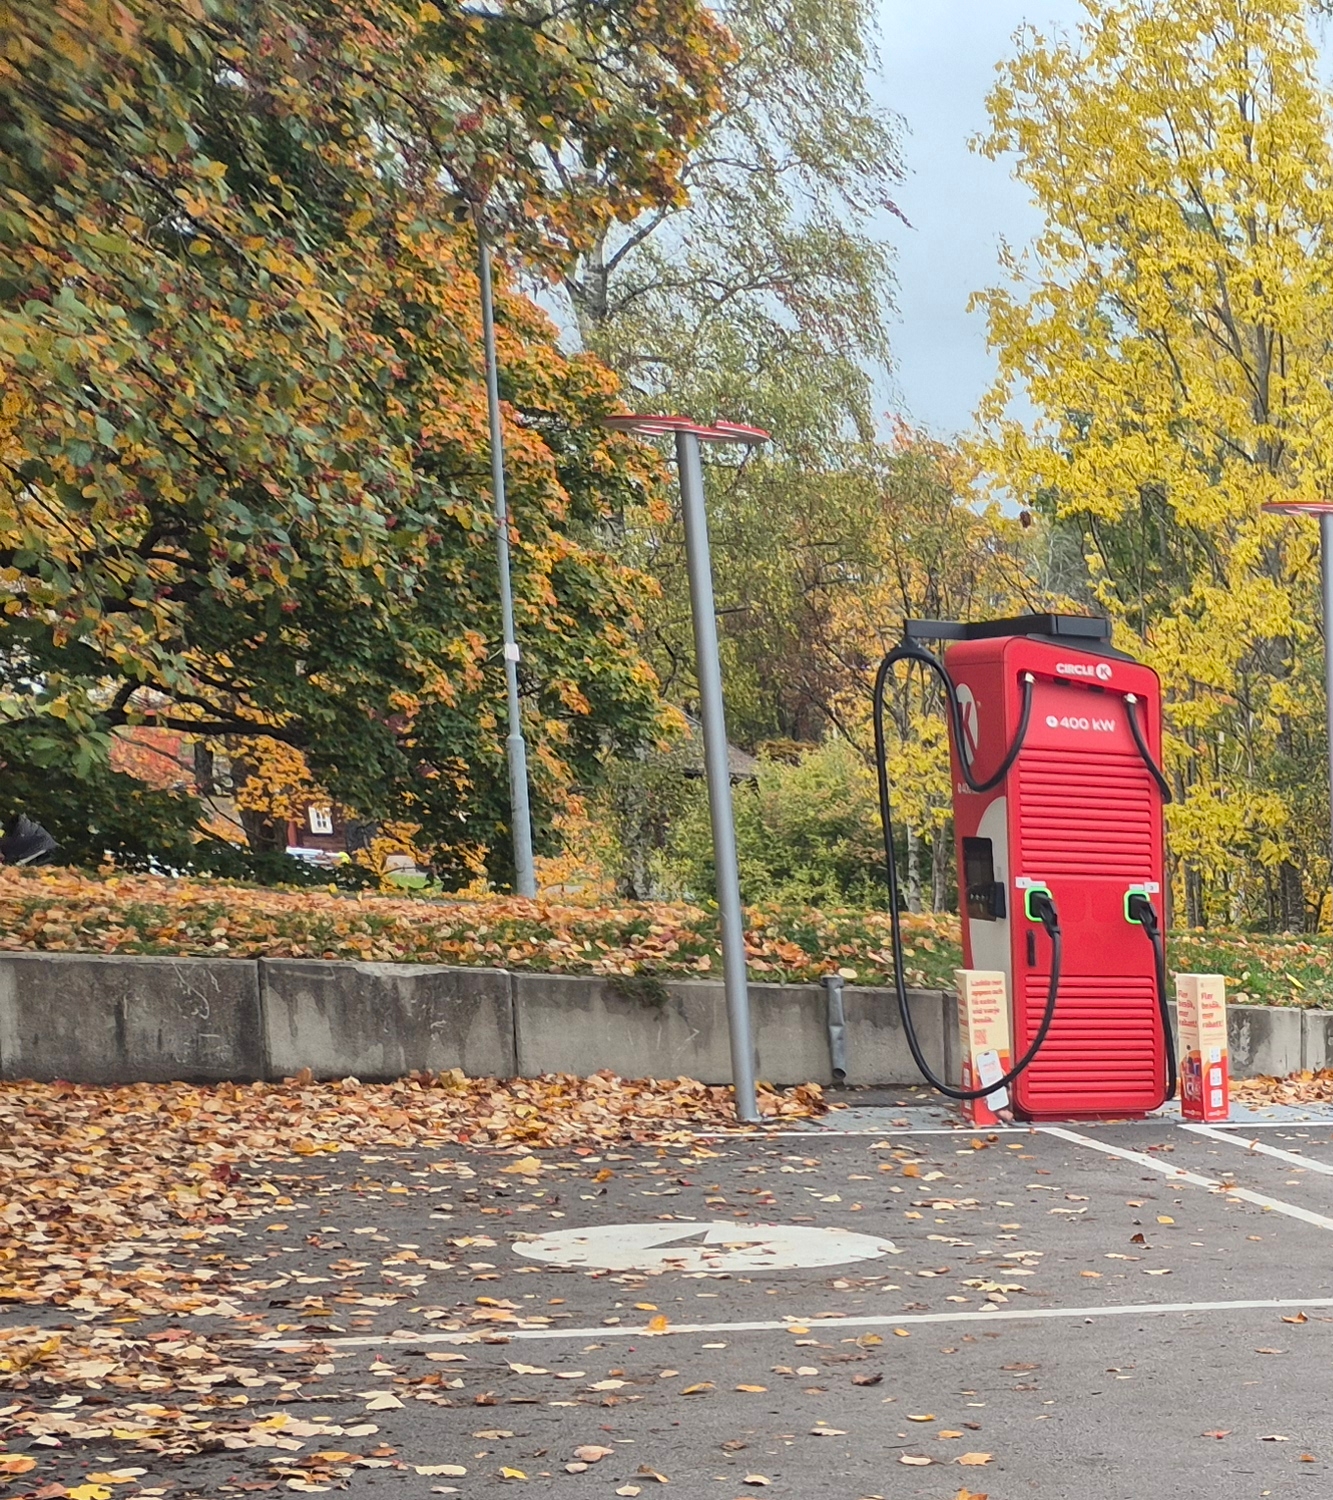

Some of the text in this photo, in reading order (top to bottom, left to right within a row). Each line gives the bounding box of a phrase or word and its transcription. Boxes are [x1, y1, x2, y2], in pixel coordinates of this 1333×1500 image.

[1055, 663, 1095, 677] CIRCLE
[1060, 716, 1116, 732] 400 kW
